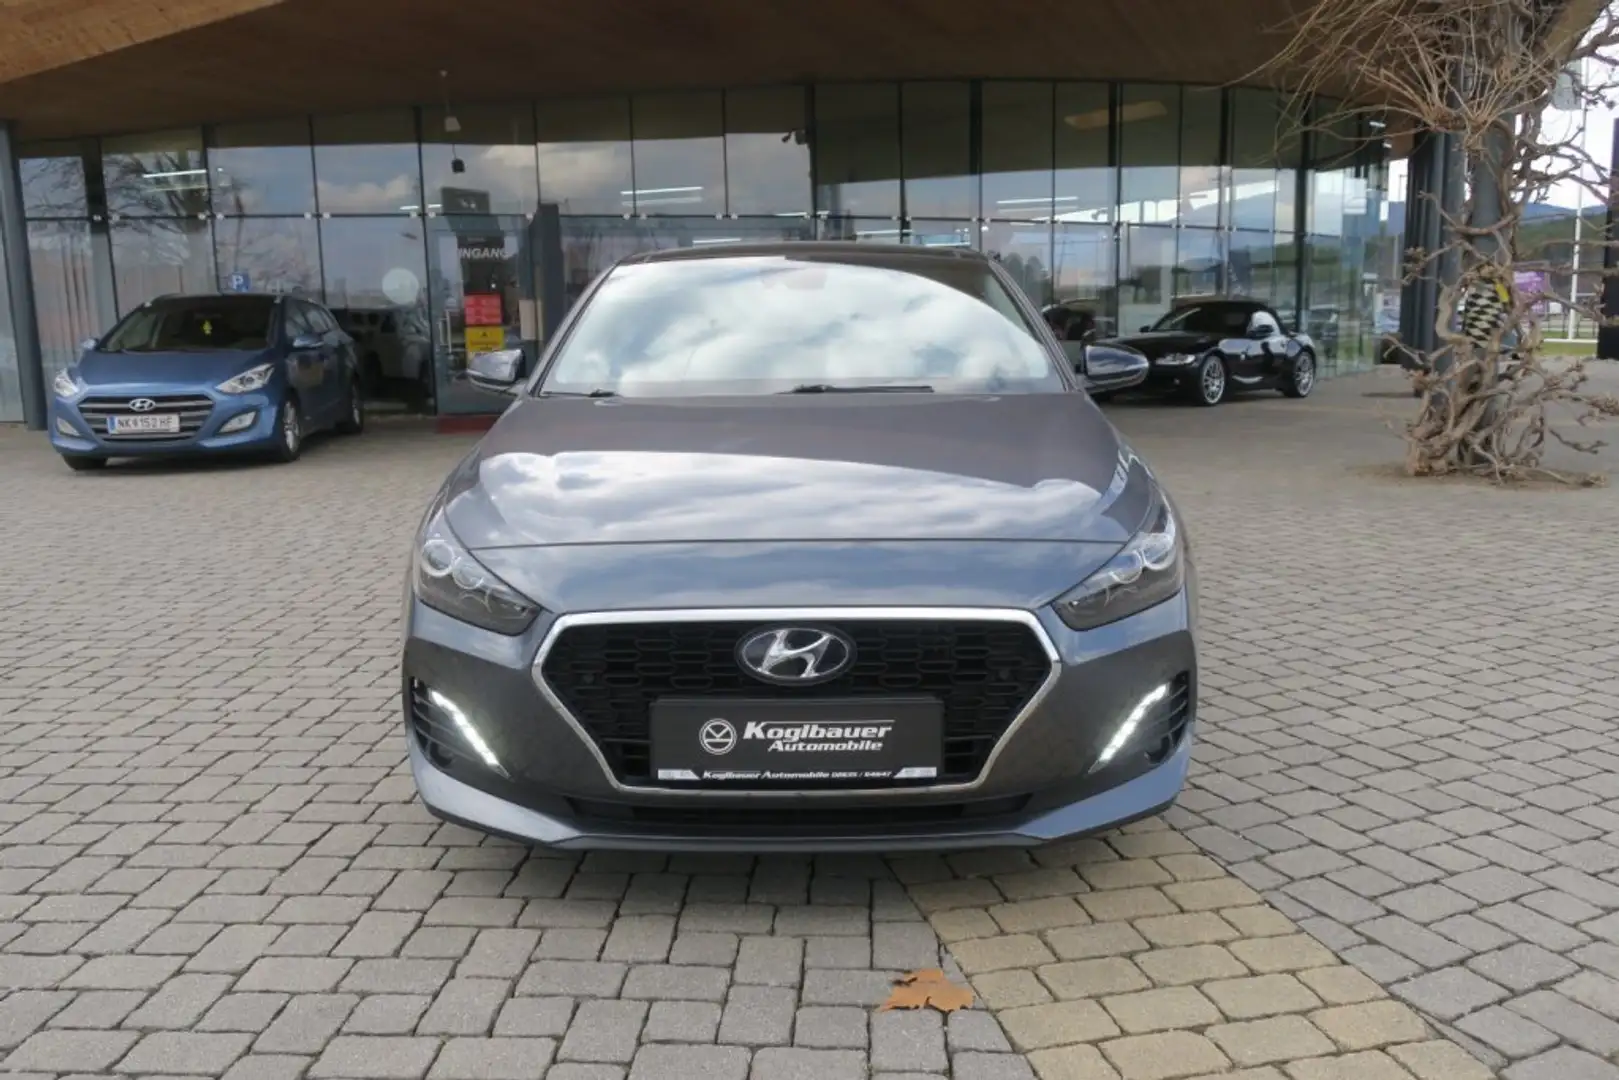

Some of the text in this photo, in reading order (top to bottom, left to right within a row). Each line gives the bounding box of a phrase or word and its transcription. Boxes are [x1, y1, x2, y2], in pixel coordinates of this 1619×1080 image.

[232, 275, 244, 290] P
[118, 418, 132, 430] NK
[139, 417, 158, 429] 152
[743, 720, 893, 743] Koglbauer
[768, 740, 883, 752] Automobile
[702, 770, 760, 780] Koglbauer
[760, 770, 830, 780] Automobile
